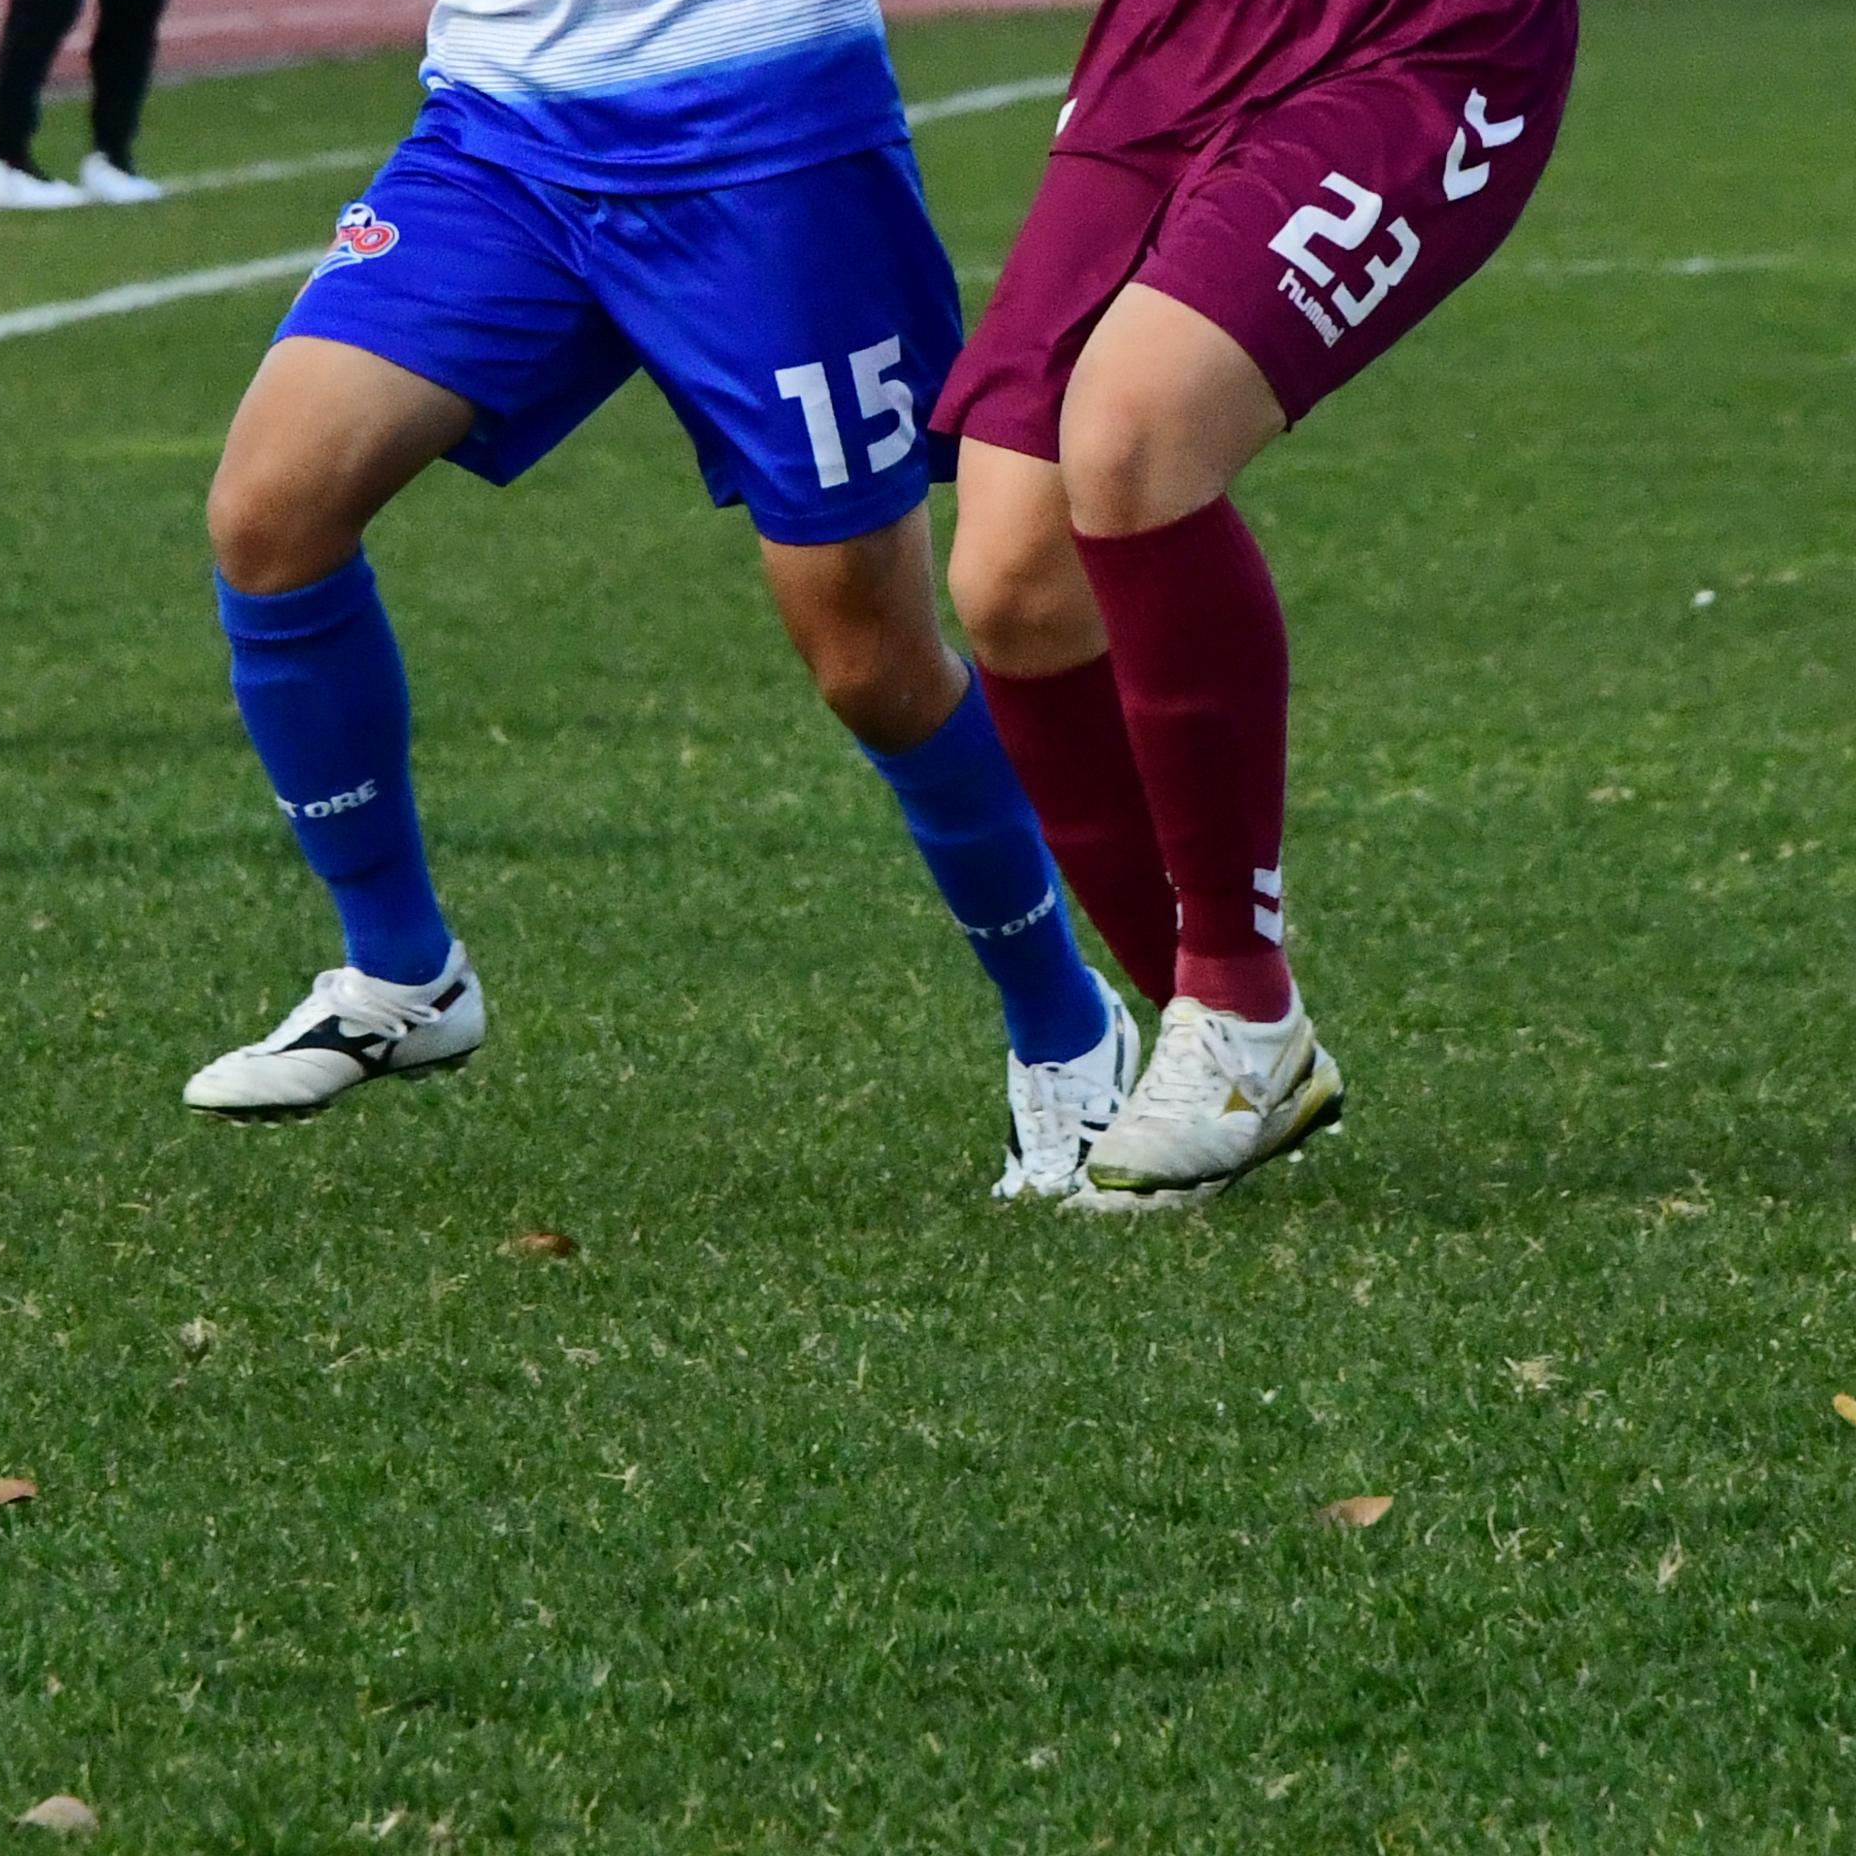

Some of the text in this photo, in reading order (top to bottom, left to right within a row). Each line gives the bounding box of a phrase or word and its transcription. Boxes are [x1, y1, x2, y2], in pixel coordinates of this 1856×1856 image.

[1267, 171, 1421, 327] 23
[1277, 267, 1345, 348] hummel
[774, 334, 916, 489] 15
[275, 778, 377, 819] TORE
